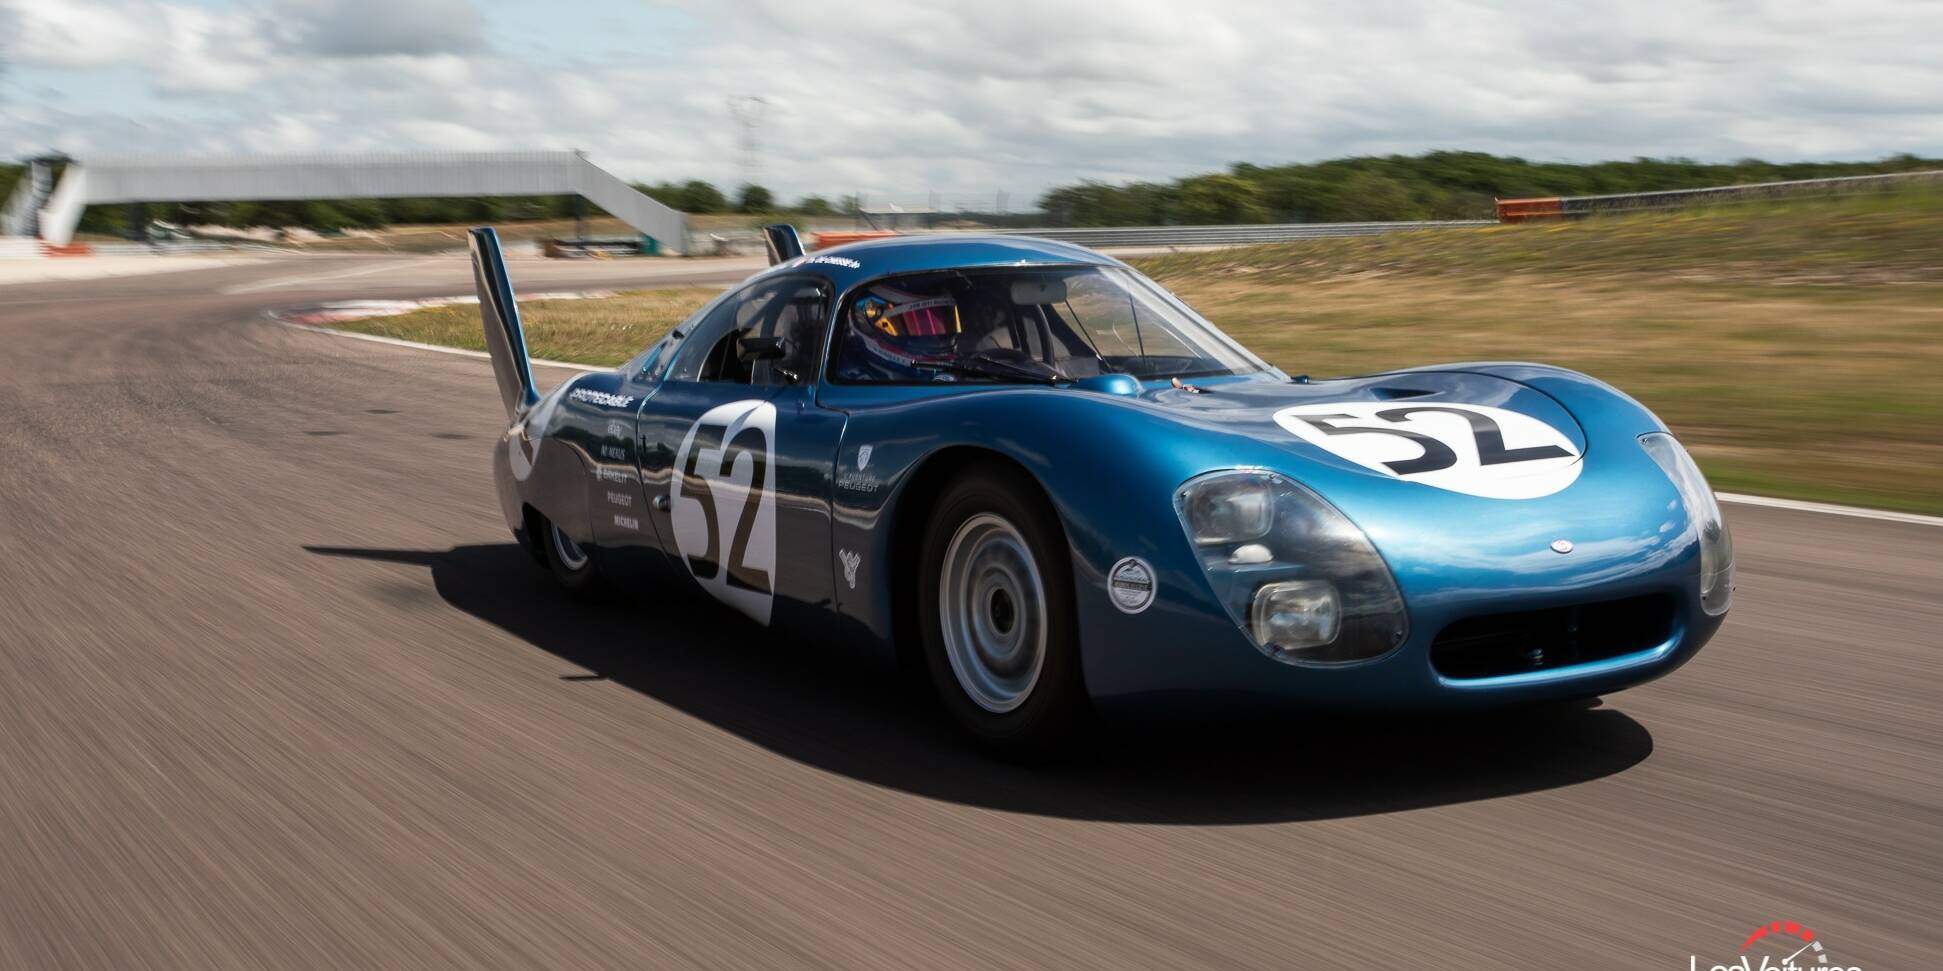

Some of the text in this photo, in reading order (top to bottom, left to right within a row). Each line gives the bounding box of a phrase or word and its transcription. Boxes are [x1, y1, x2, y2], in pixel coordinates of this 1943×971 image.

[1291, 406, 1576, 475] 52
[838, 479, 879, 492] PEUGEOT
[607, 491, 632, 507] PEUGEOT
[680, 424, 772, 596] 52
[614, 514, 639, 530] MICHELIN
